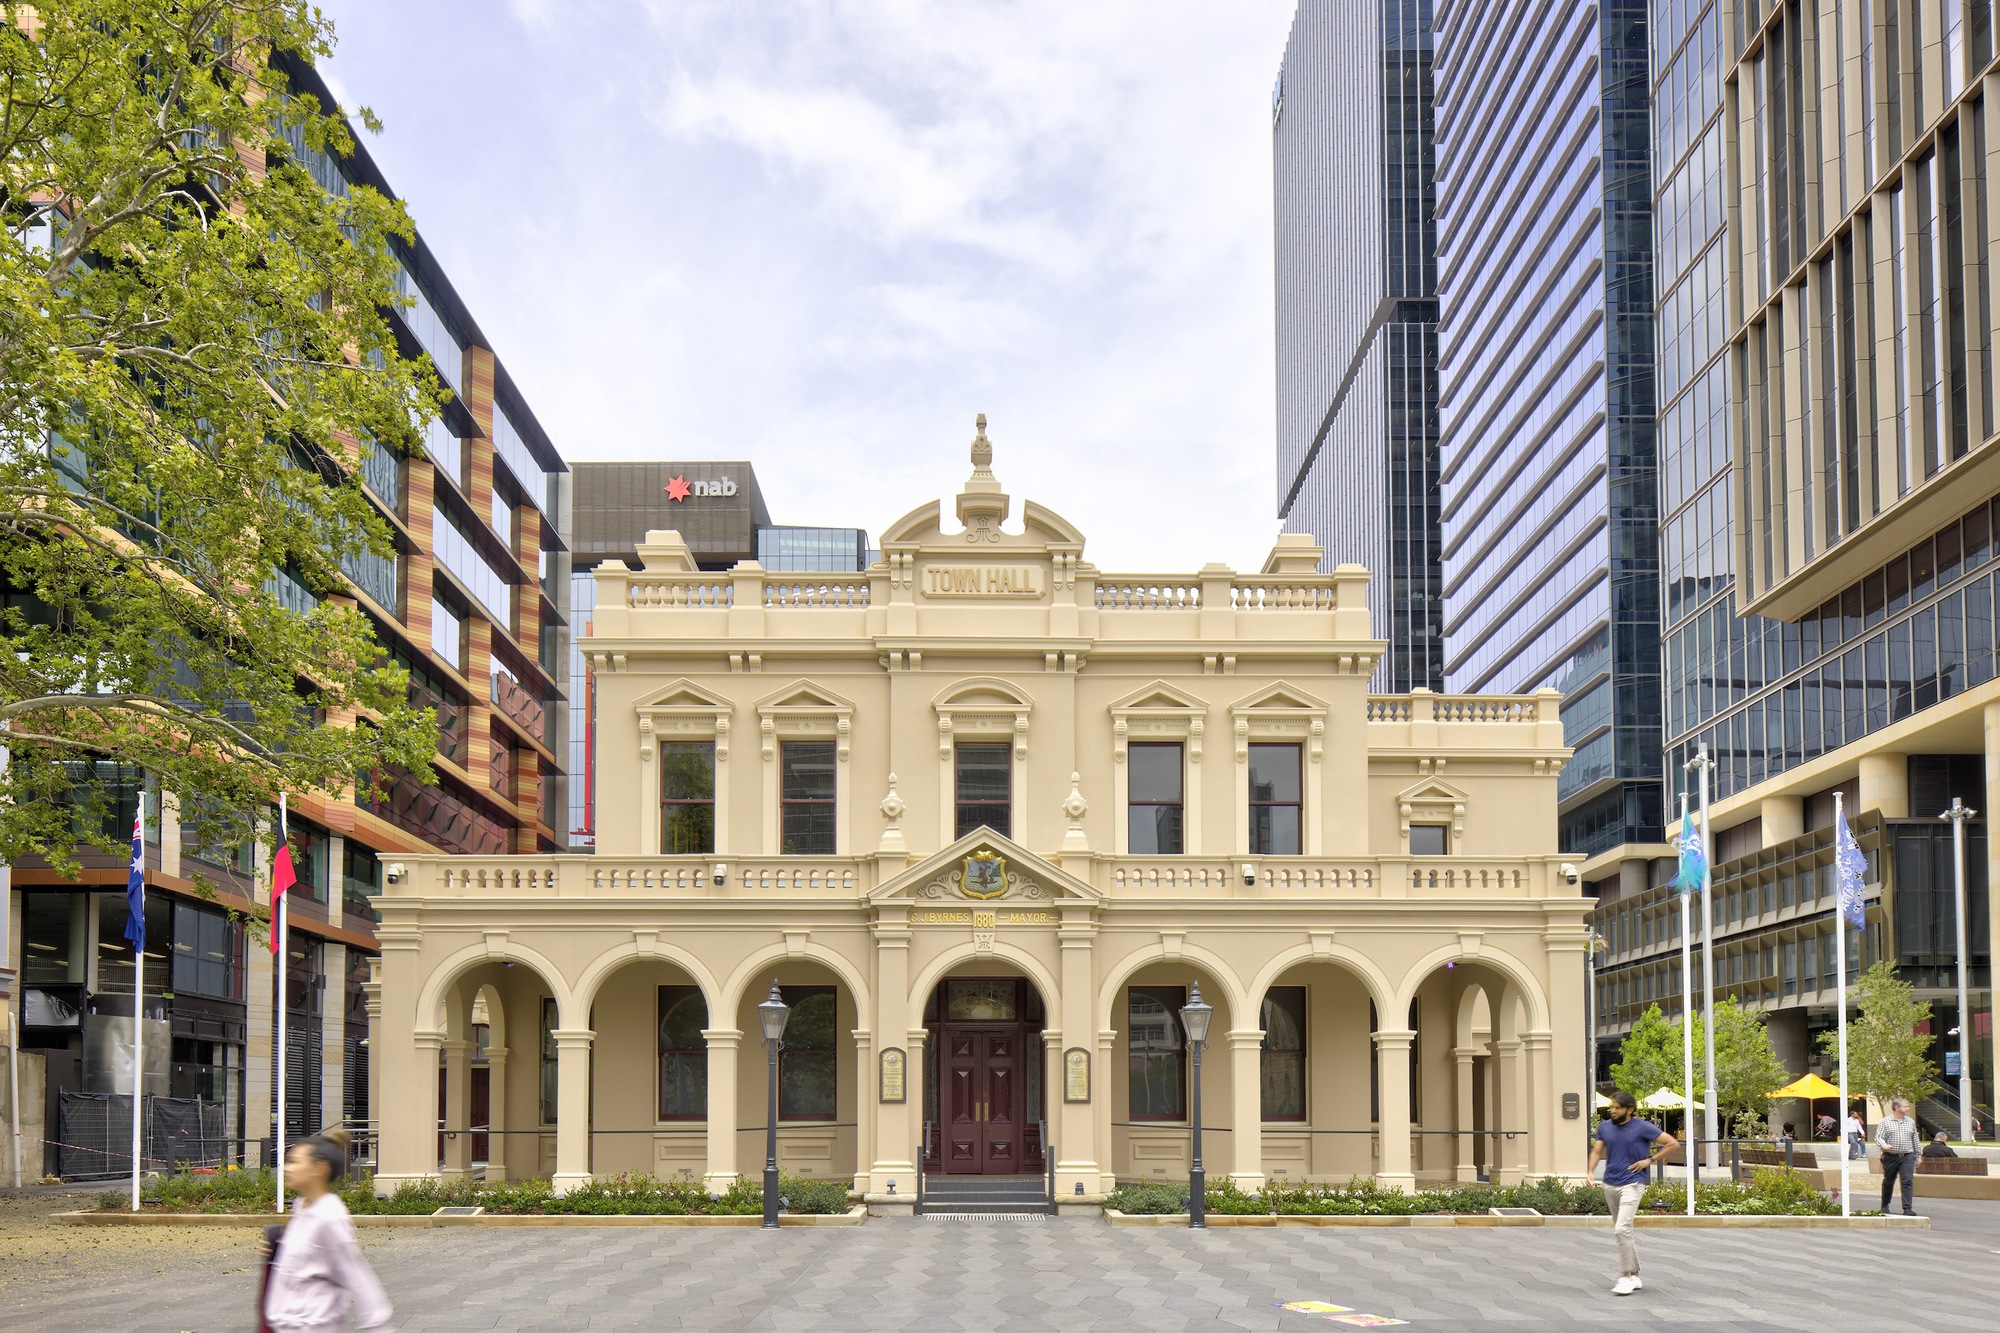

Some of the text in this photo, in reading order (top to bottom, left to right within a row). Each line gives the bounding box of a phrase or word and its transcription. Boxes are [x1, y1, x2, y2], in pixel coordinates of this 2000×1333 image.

[694, 476, 737, 496] nab
[928, 568, 1036, 593] TOWN HALL
[974, 913, 994, 928] 1880
